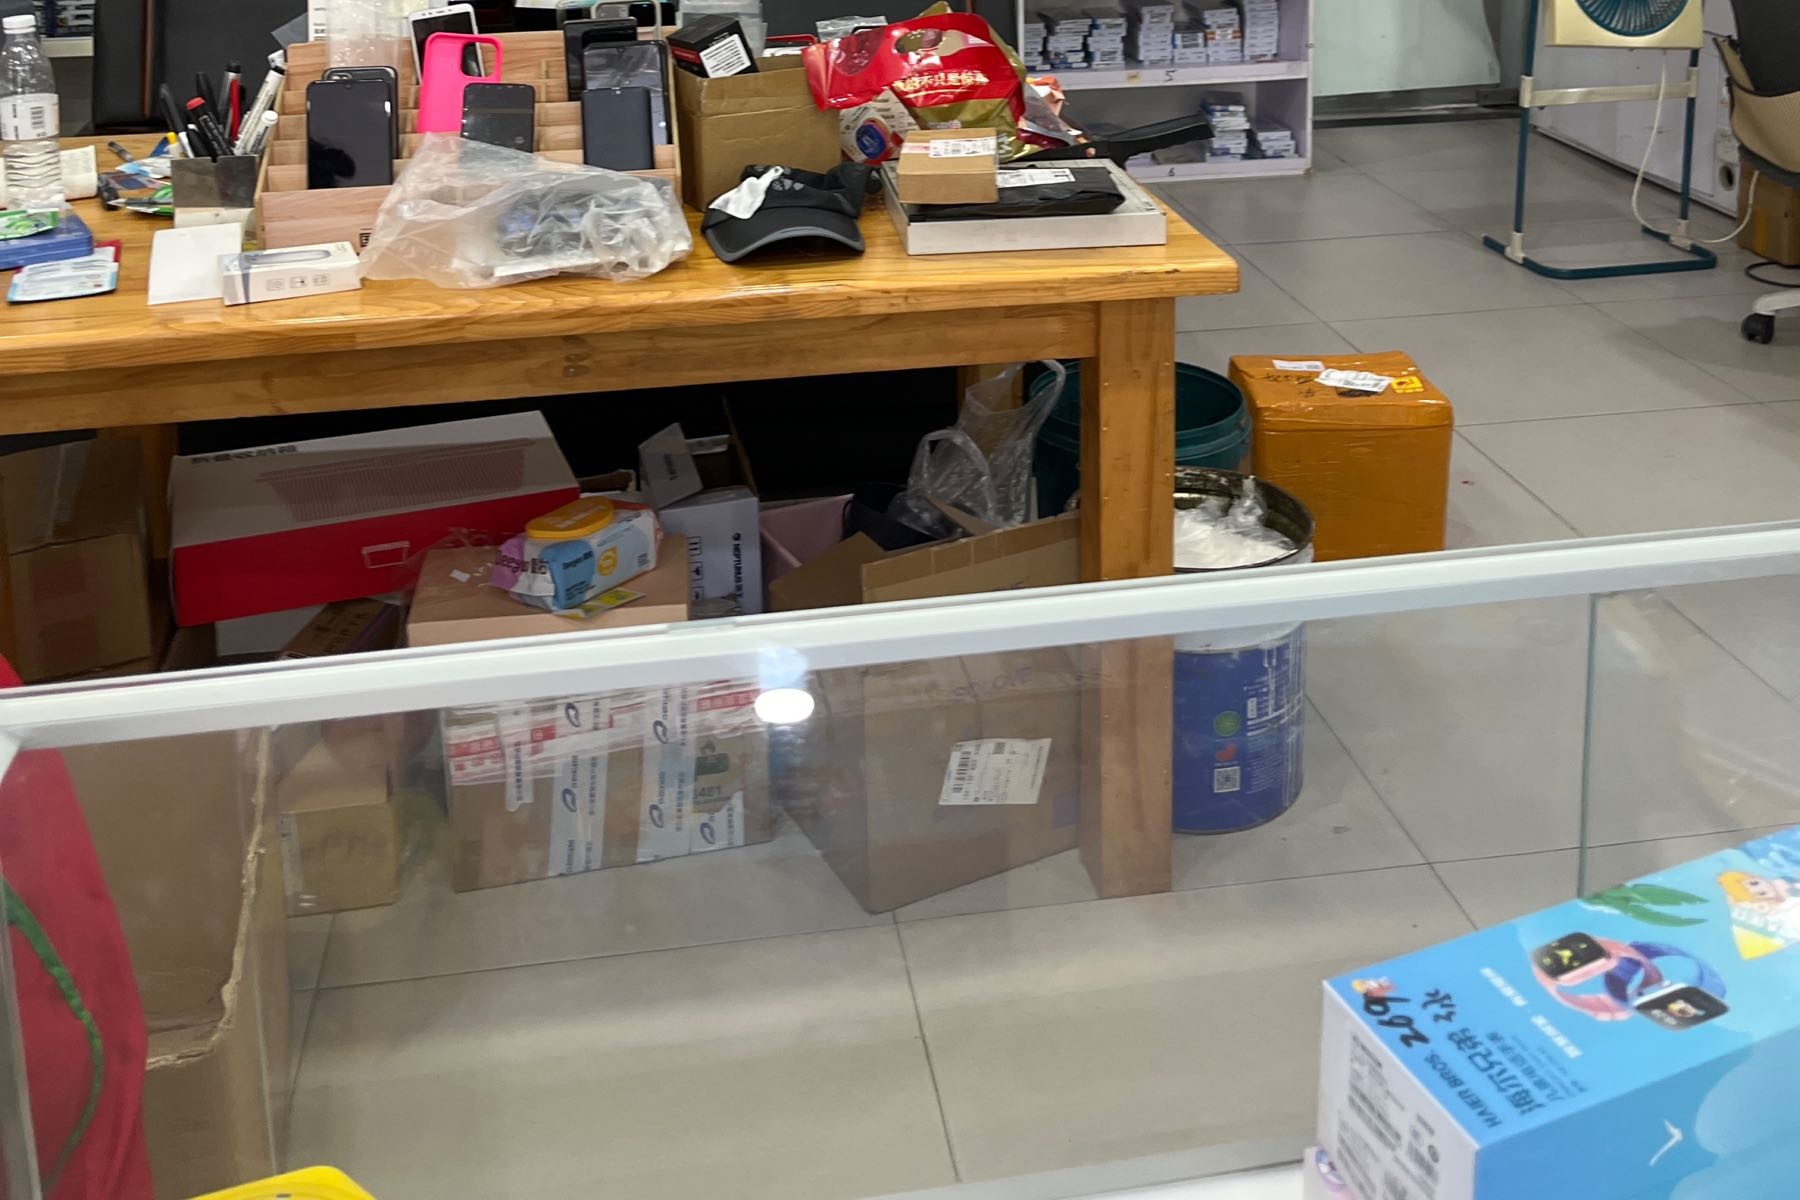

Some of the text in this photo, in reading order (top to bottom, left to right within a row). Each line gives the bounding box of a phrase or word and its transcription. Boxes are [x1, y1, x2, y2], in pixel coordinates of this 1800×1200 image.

[1447, 1027, 1546, 1116] 海尔兄弟
[1458, 1083, 1502, 1129] HAIER
